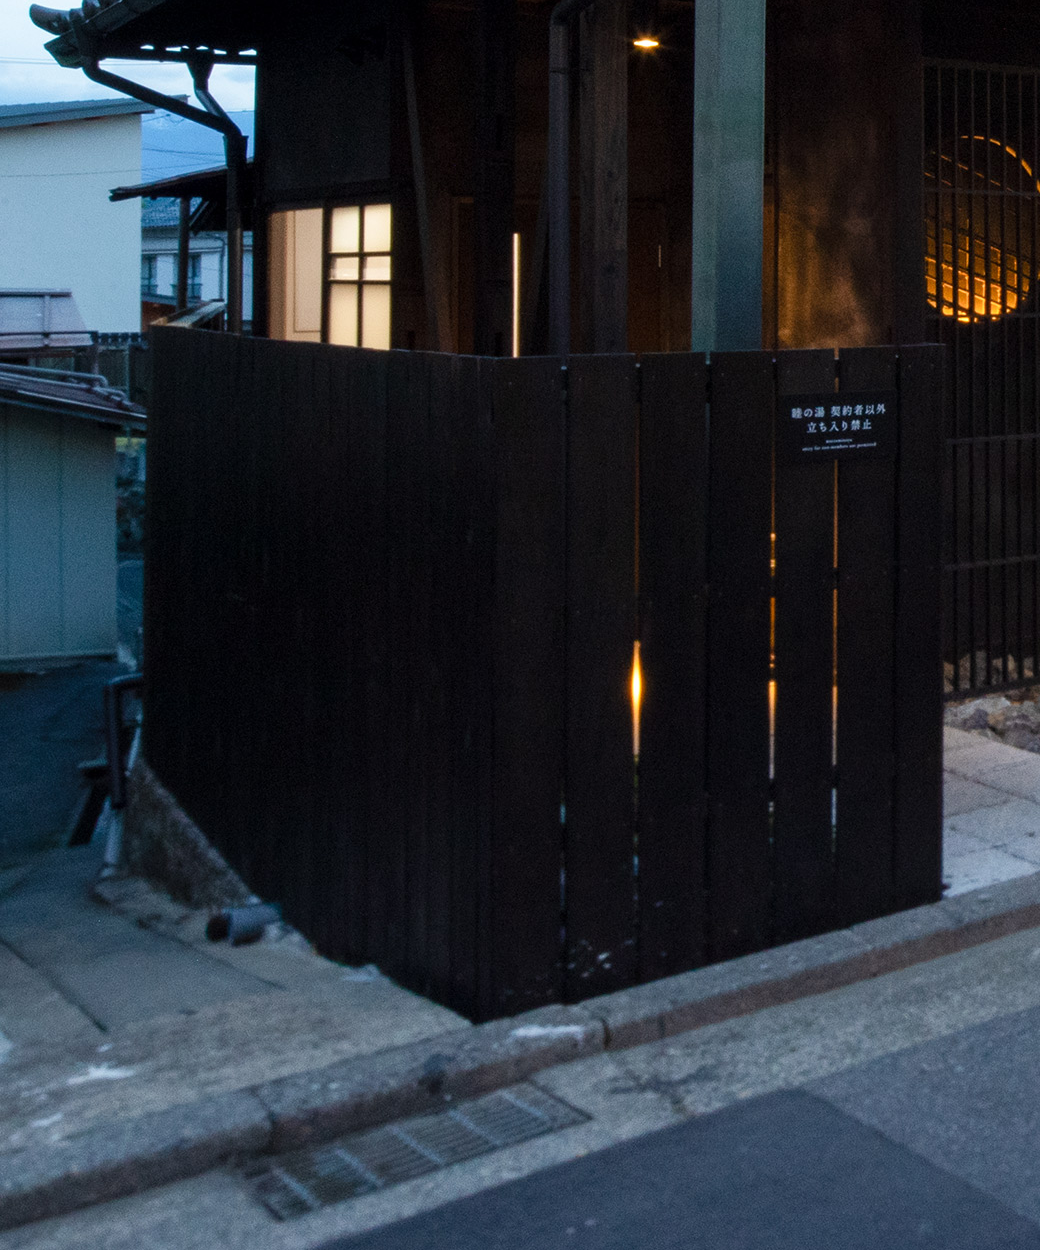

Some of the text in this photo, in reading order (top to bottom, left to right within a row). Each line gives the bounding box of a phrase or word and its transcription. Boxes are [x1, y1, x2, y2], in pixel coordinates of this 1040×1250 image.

[831, 403, 886, 417] 契約者以外
[806, 419, 871, 433] 立ち入り禁止
